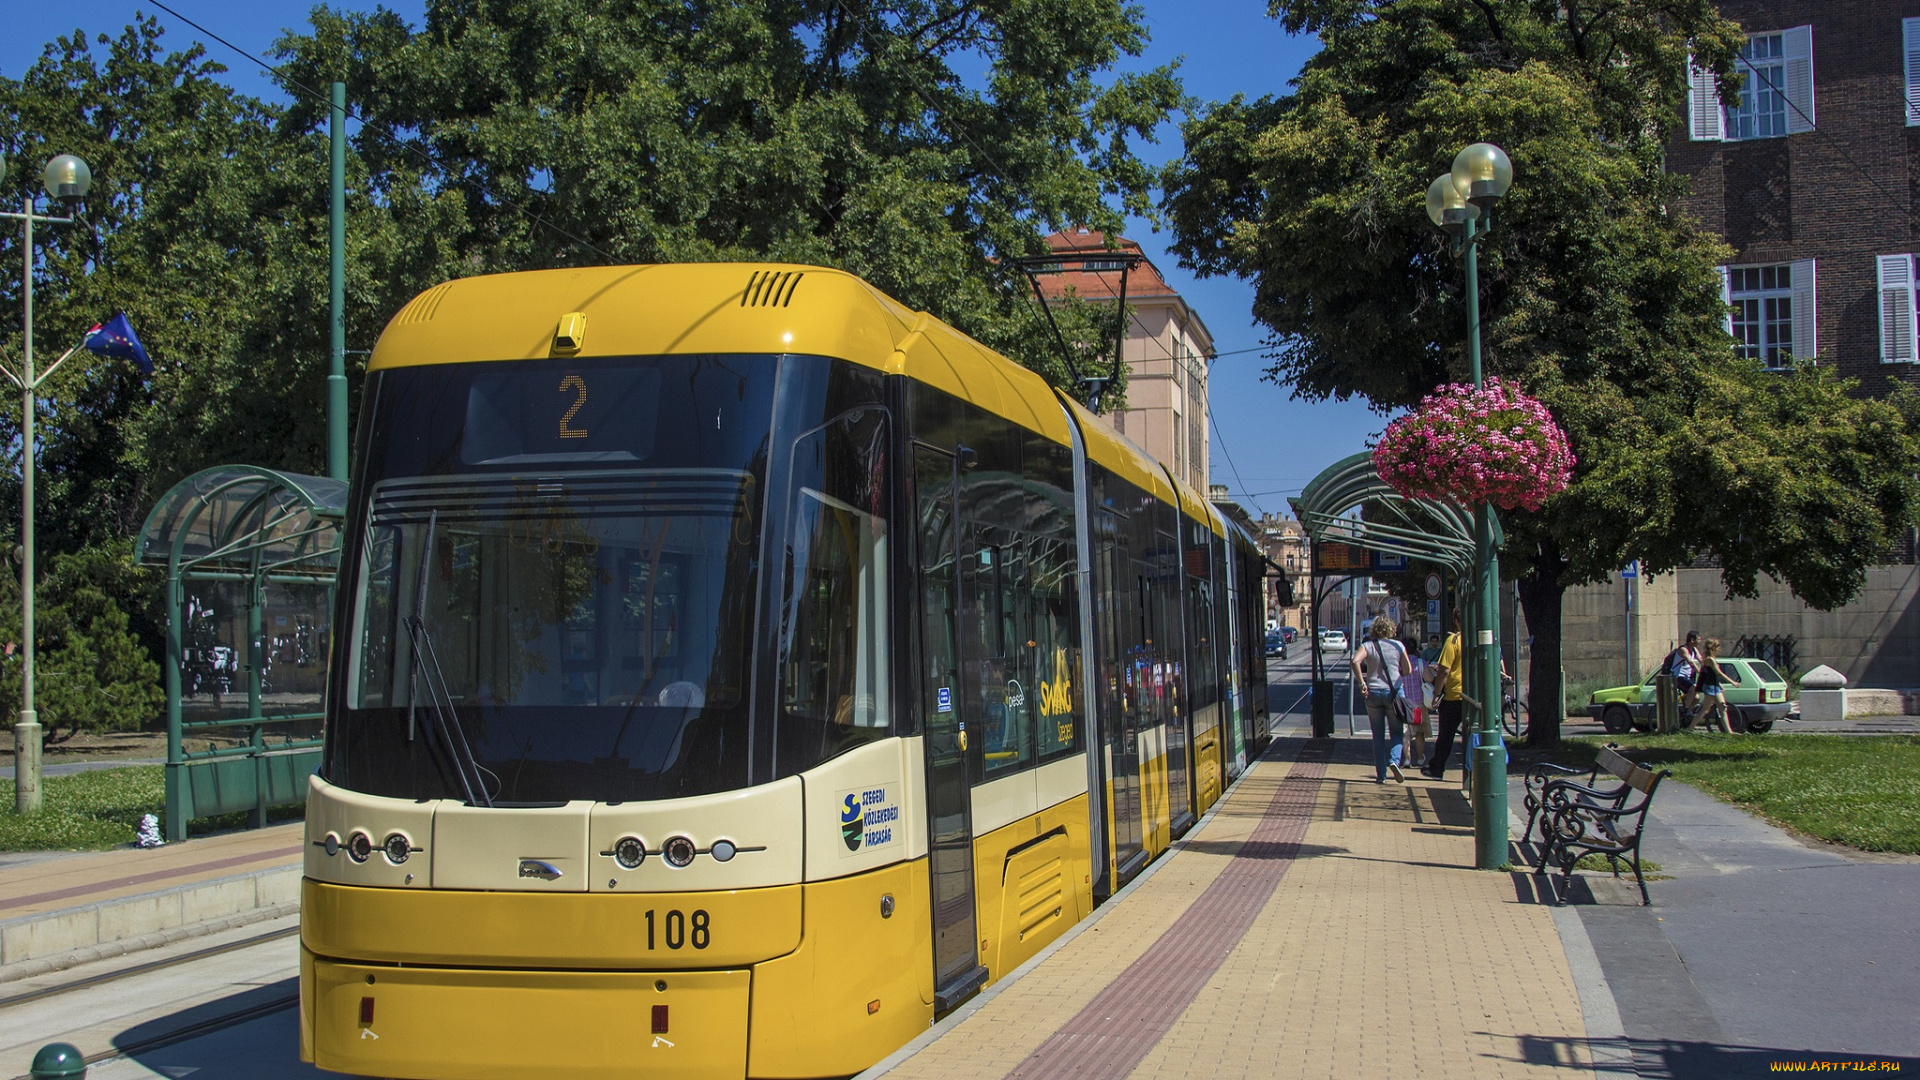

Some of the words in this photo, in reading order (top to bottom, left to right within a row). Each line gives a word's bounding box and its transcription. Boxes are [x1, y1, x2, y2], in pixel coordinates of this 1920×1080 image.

[559, 375, 588, 439] 2
[1057, 719, 1074, 746] Szeged
[862, 788, 885, 806] SZEGEDI
[864, 825, 892, 848] TÁRSASÁG
[645, 909, 710, 950] 108
